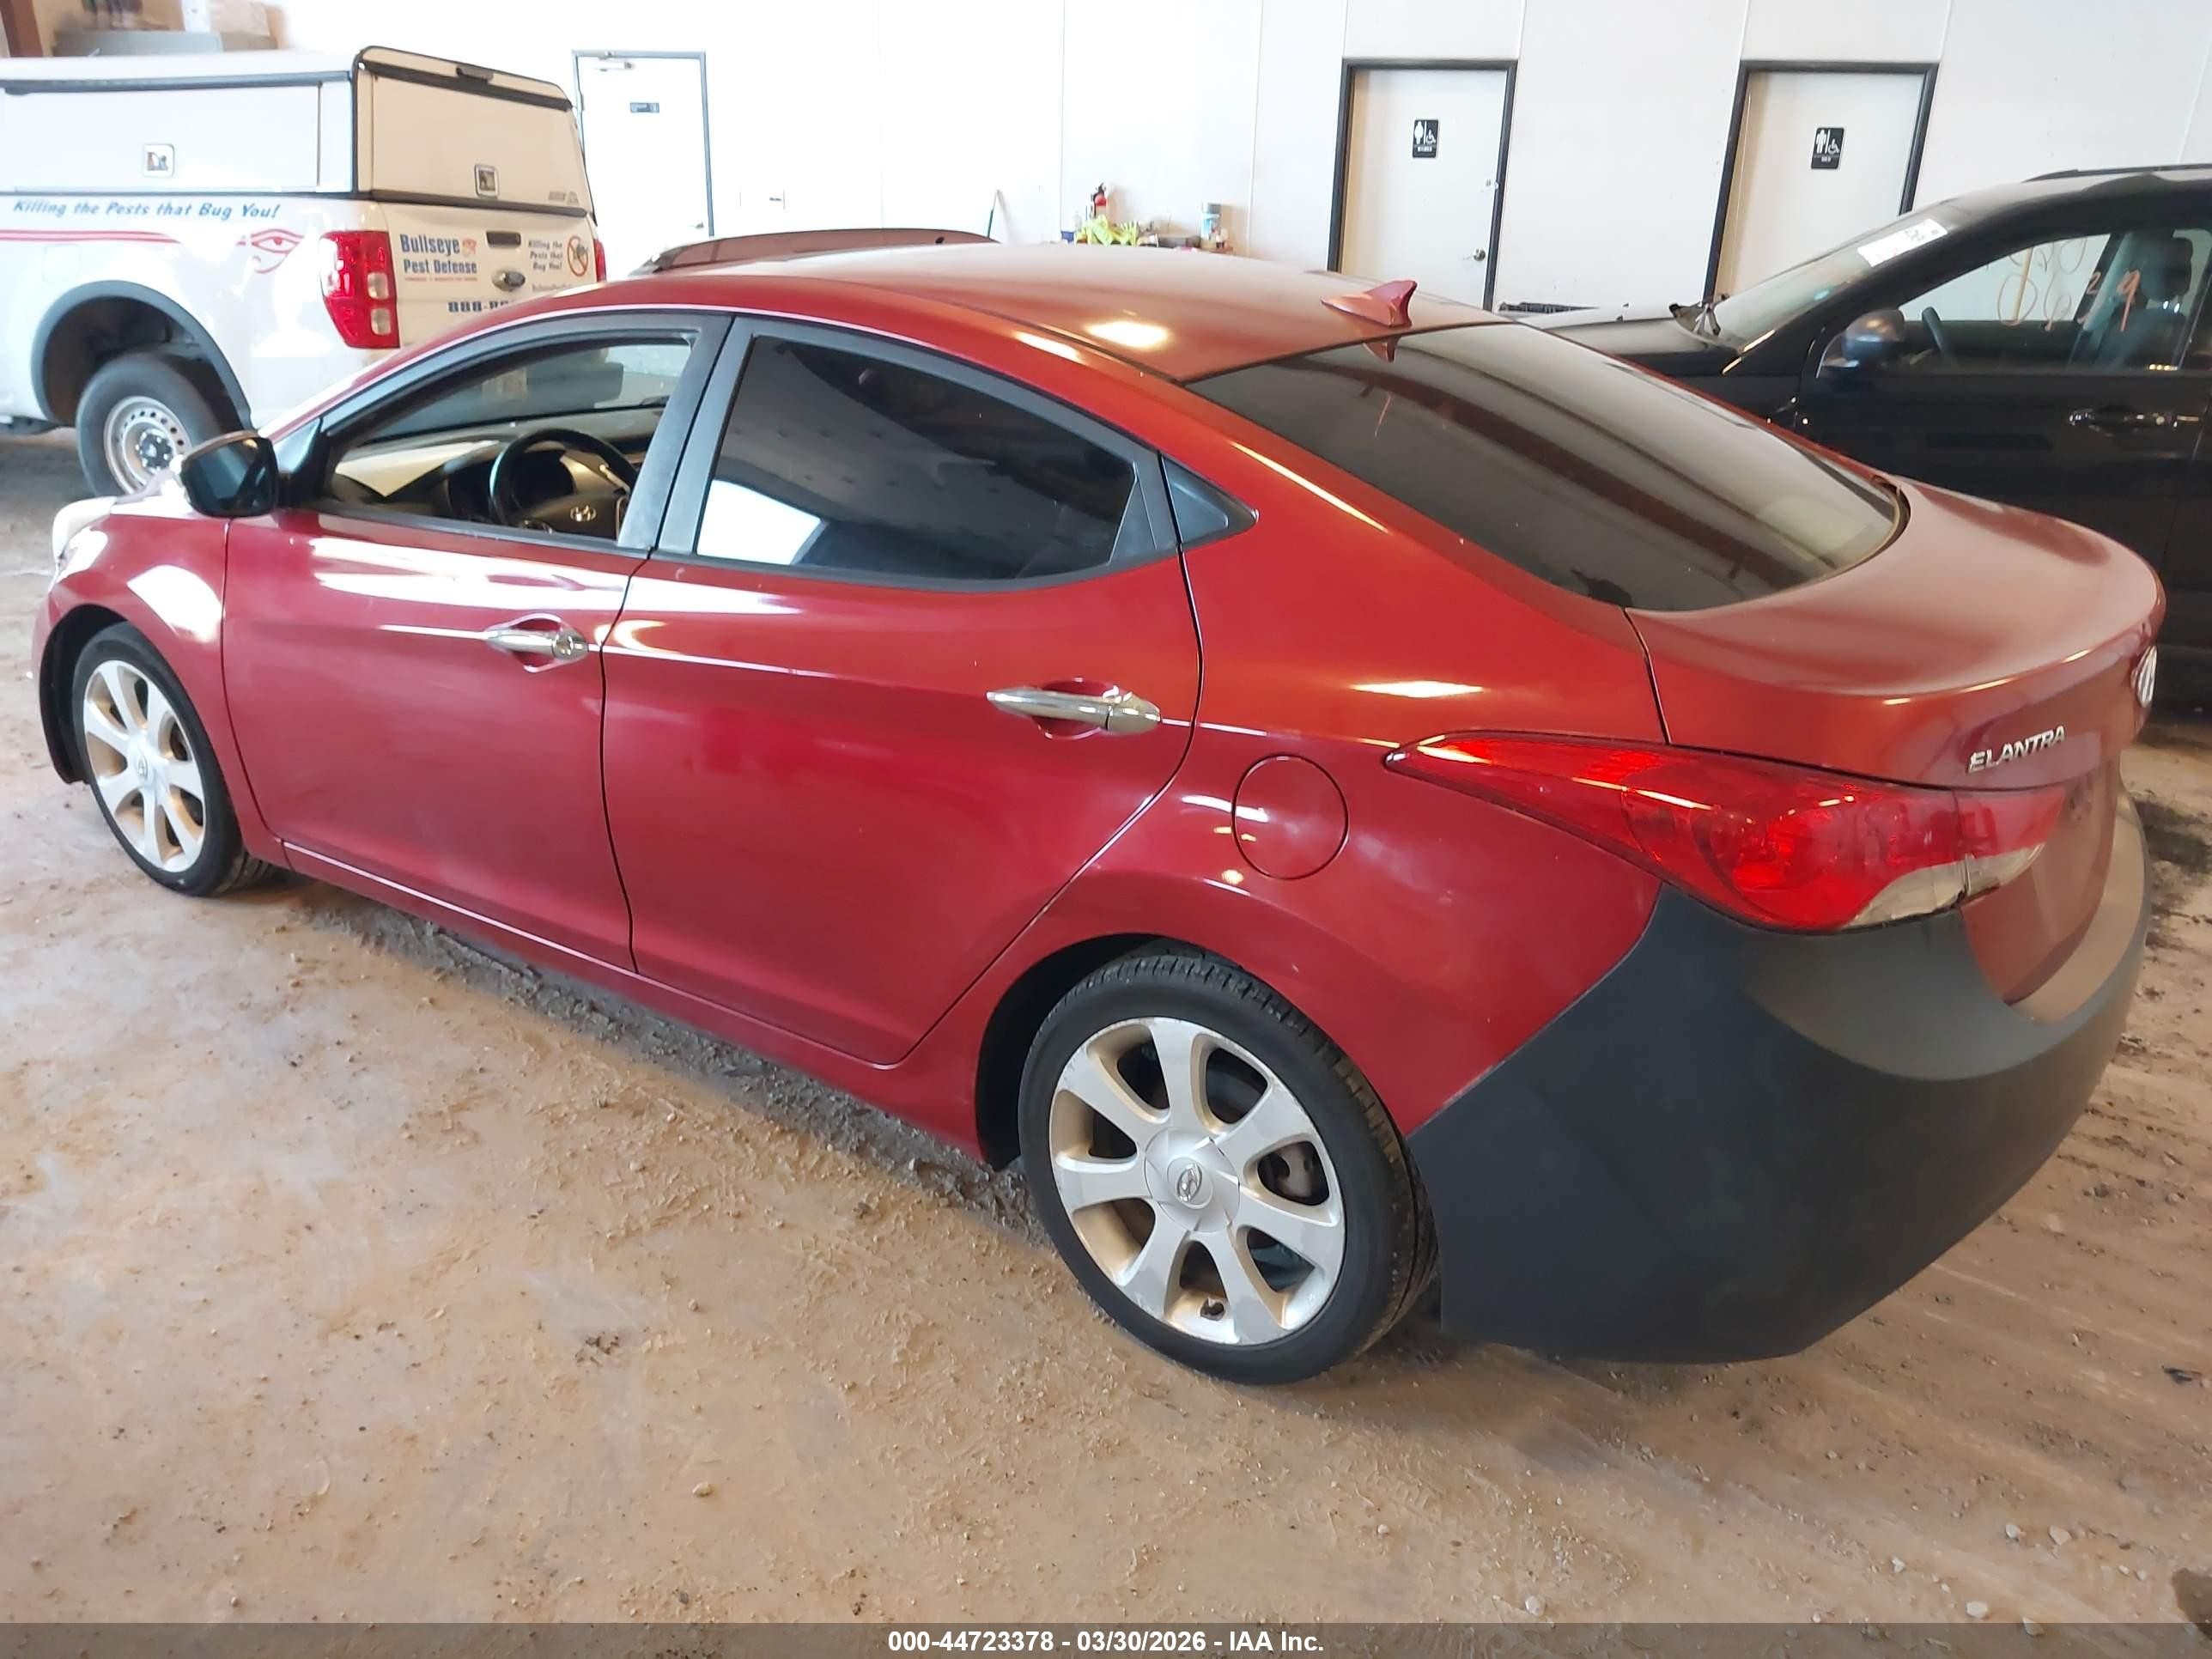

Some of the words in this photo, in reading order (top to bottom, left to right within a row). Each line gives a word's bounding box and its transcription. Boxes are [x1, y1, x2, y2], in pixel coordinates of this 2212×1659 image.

[13, 199, 67, 218] Killing
[74, 202, 100, 214] the
[106, 202, 149, 216] Pests
[155, 203, 192, 216] that
[198, 203, 233, 221] Bug
[241, 204, 281, 218] You!
[400, 234, 460, 256] Bullseye
[528, 240, 550, 250] Killing
[530, 251, 548, 259] Pests
[404, 258, 430, 274] Pest
[434, 259, 477, 274] Defense
[532, 262, 546, 272] Bug
[1967, 725, 2066, 775] ELANTRA
